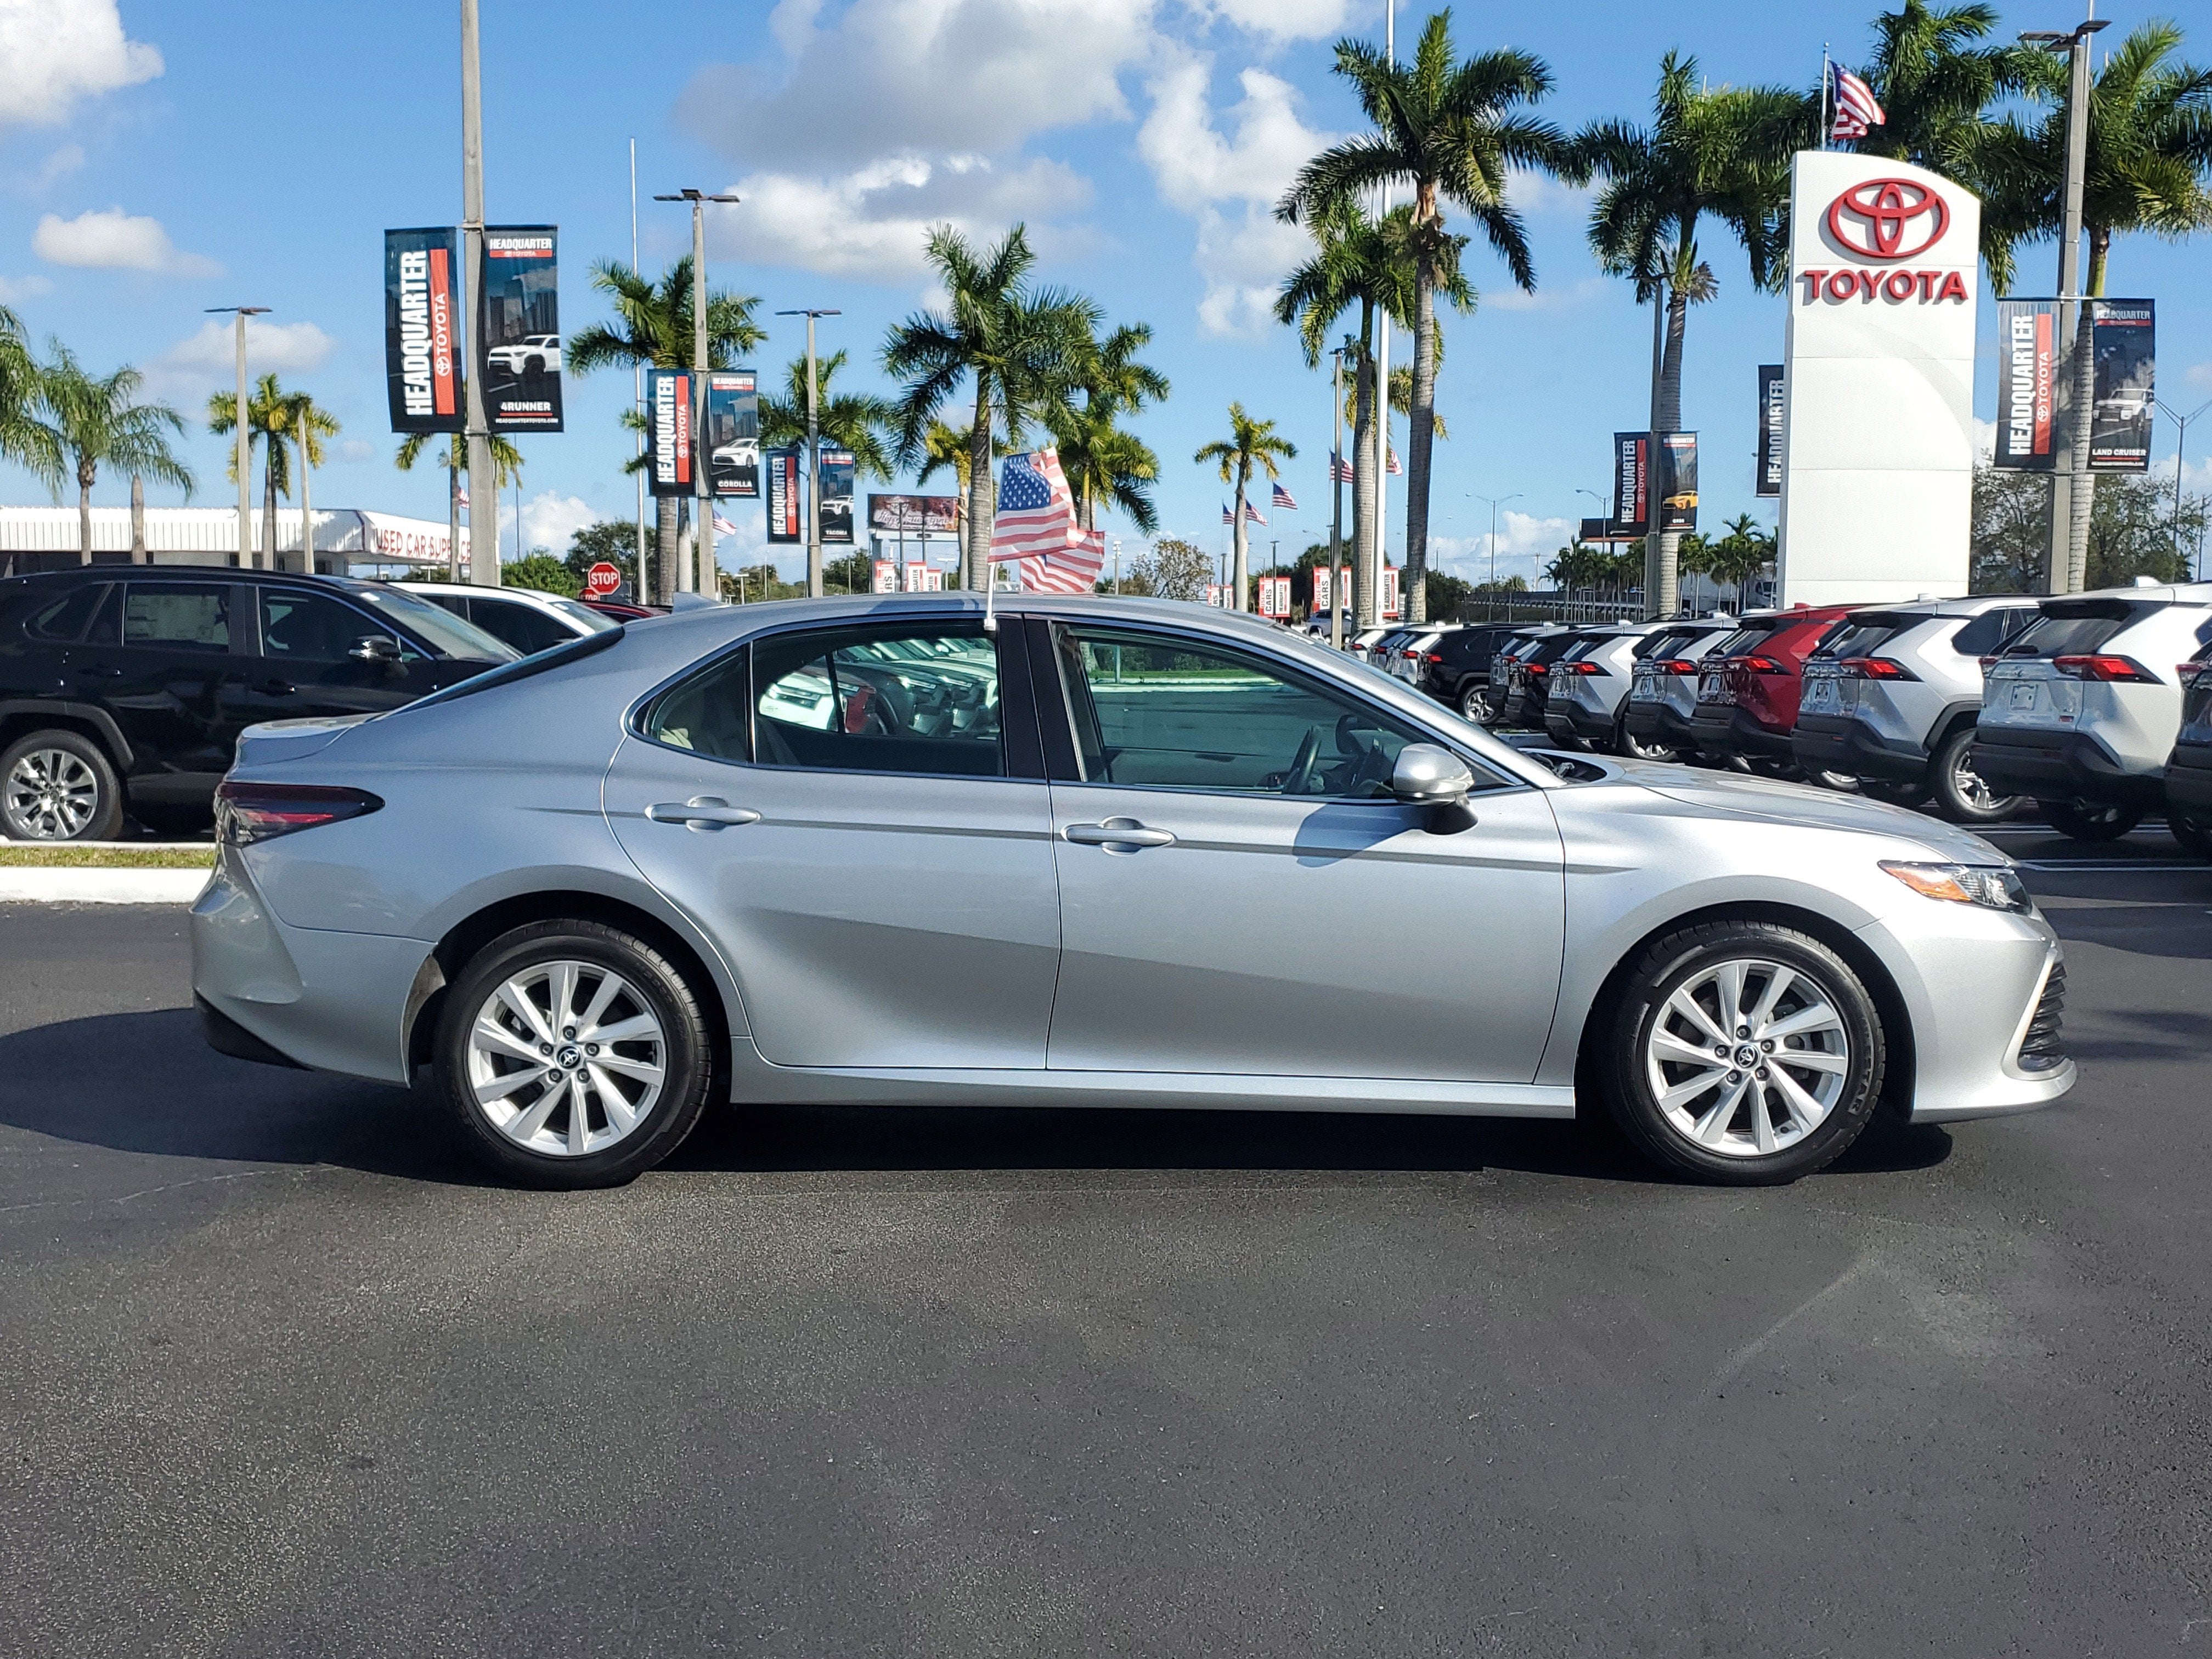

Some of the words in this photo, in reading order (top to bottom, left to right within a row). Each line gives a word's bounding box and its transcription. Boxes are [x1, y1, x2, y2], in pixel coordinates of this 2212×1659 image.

[490, 238, 552, 250] HEADQUARTER
[1803, 269, 1968, 300] TOYOTA
[401, 250, 432, 415] HEADQUARTER
[435, 293, 448, 357] TOYOTA
[2097, 309, 2151, 320] HEADQUARTER
[2008, 315, 2036, 455] HEADQUARTER
[2039, 351, 2049, 404] TOYOTA
[500, 402, 551, 411] 4RUNNER
[678, 404, 687, 445] TOYOTA
[656, 376, 677, 483] HEADQUARTER
[718, 479, 752, 488] COROLLA
[772, 457, 787, 534] HEADQUARTER
[1621, 439, 1637, 523] HEADQUARTER
[375, 528, 403, 554] USED
[407, 533, 426, 557] CAR
[591, 571, 618, 585] STOP
